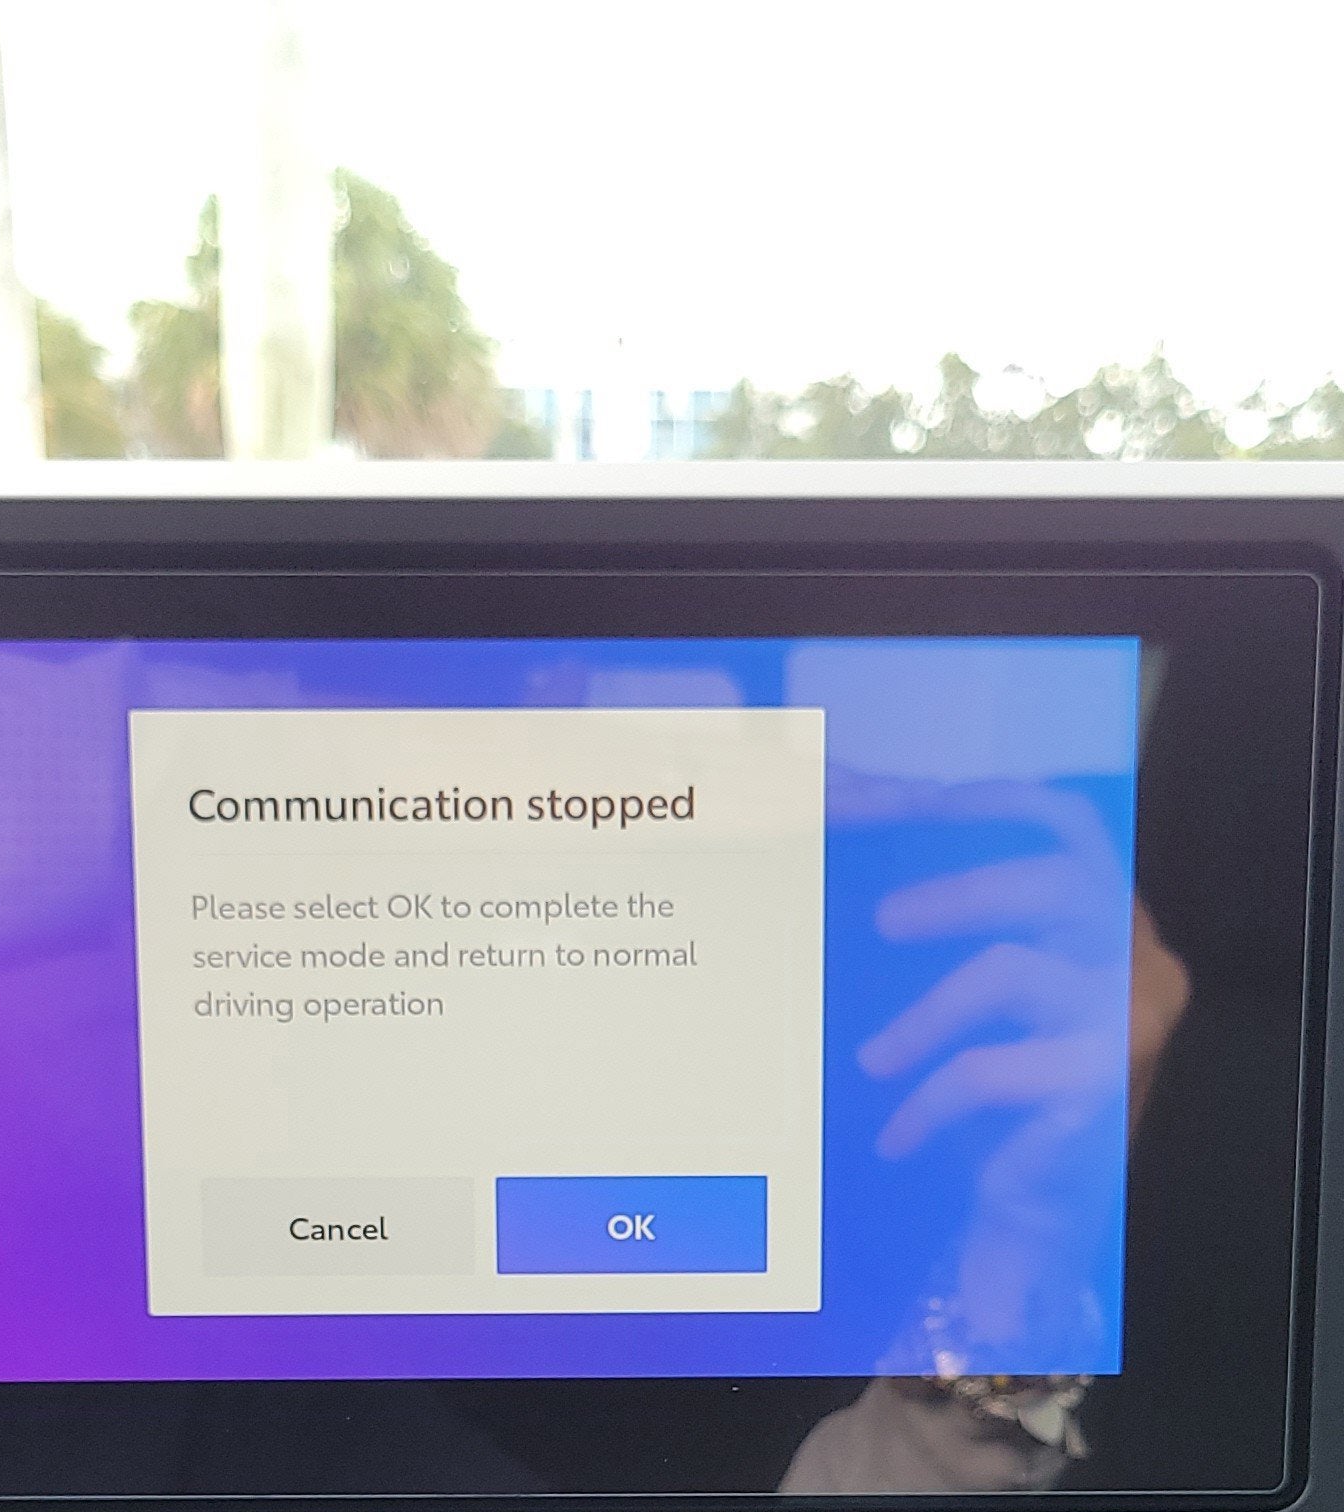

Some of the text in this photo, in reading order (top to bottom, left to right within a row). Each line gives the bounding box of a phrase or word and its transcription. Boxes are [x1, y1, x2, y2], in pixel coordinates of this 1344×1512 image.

[189, 786, 696, 830] Communication stopped
[192, 893, 675, 925] Please select OK to complete the
[193, 941, 698, 969] service mode and return to normal
[194, 991, 444, 1023] driving operation
[289, 1216, 389, 1241] Cancel
[607, 1214, 656, 1241] OK
